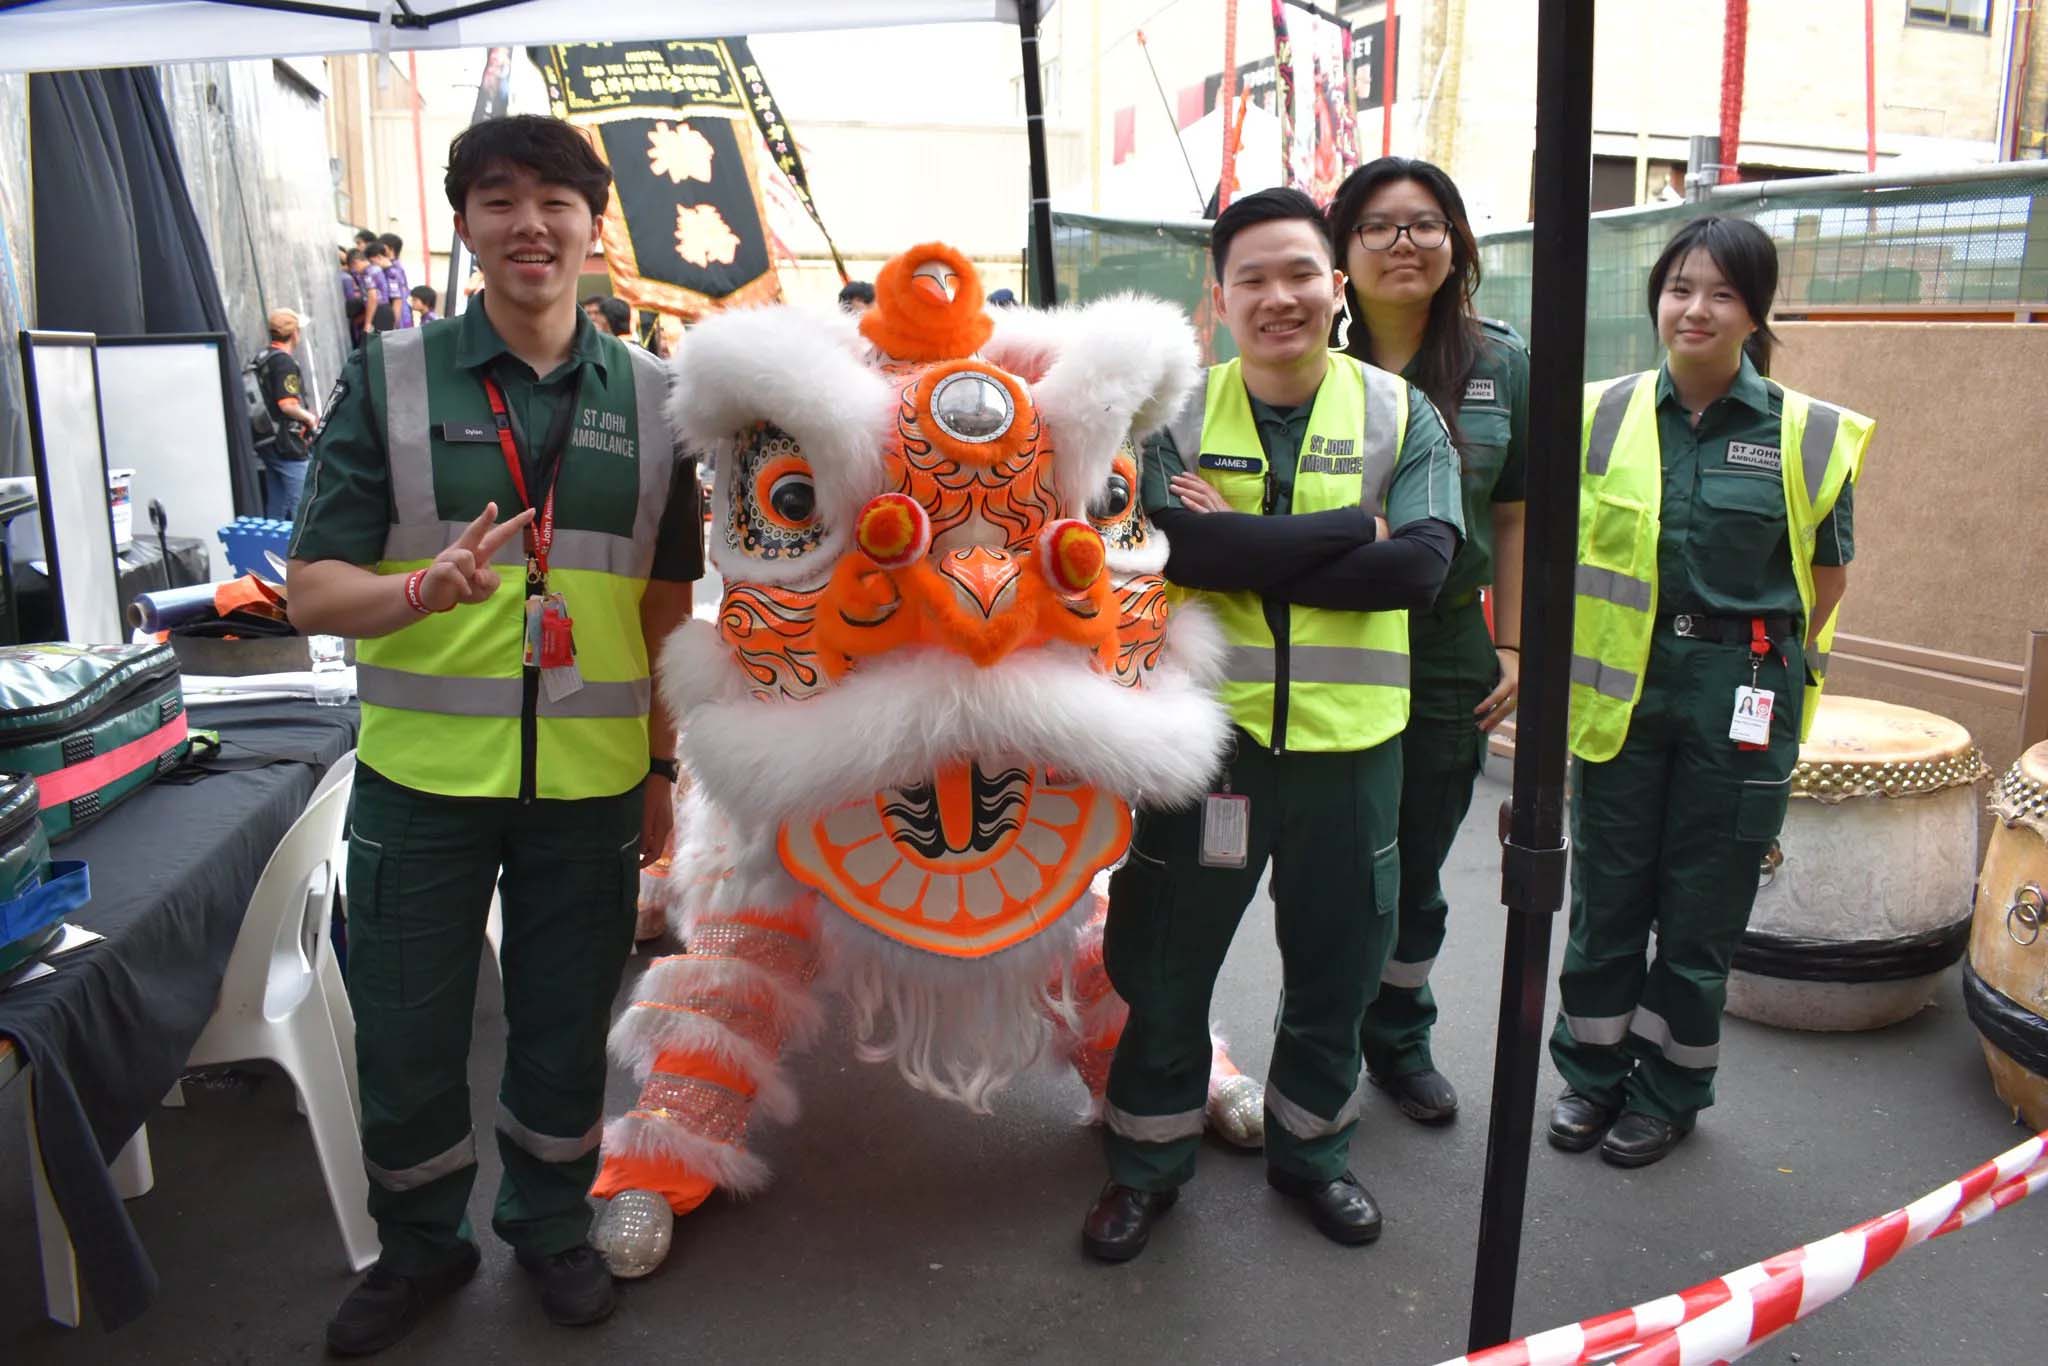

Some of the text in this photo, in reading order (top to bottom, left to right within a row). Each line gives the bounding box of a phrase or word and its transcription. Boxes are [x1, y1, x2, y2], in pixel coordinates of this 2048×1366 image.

[1468, 382, 1491, 390] OHN
[583, 408, 627, 434] ST JOHN
[571, 427, 634, 458] AMBULANCE
[1311, 435, 1354, 455] ST JOHN
[1731, 454, 1779, 467] AMBULANCE
[1732, 445, 1781, 460] ST JOHN
[1214, 457, 1248, 469] JAMES
[1301, 455, 1362, 474] AMBULANCE
[542, 521, 552, 544] John
